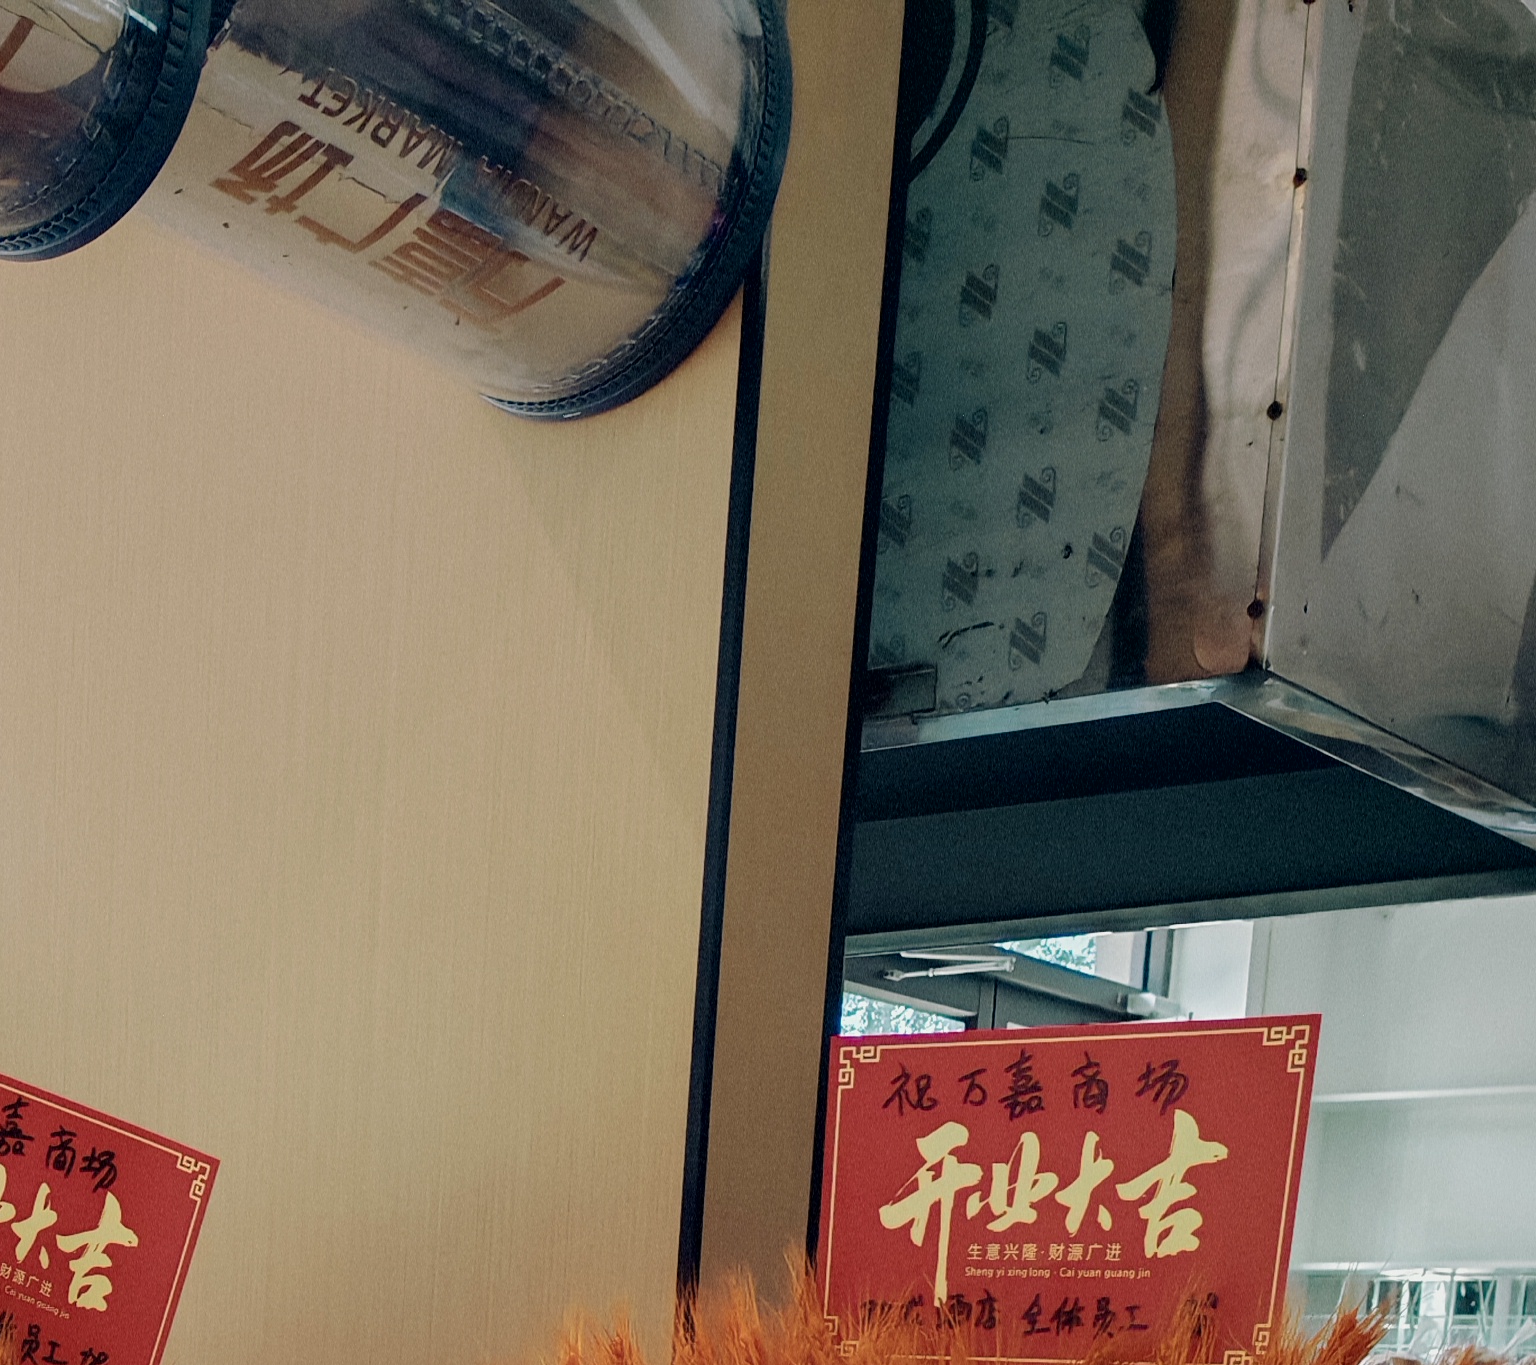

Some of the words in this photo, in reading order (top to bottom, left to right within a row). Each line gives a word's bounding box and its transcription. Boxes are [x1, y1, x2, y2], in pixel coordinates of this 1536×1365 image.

[297, 66, 454, 178] MARKET
[878, 1109, 1229, 1307] 开业大吉
